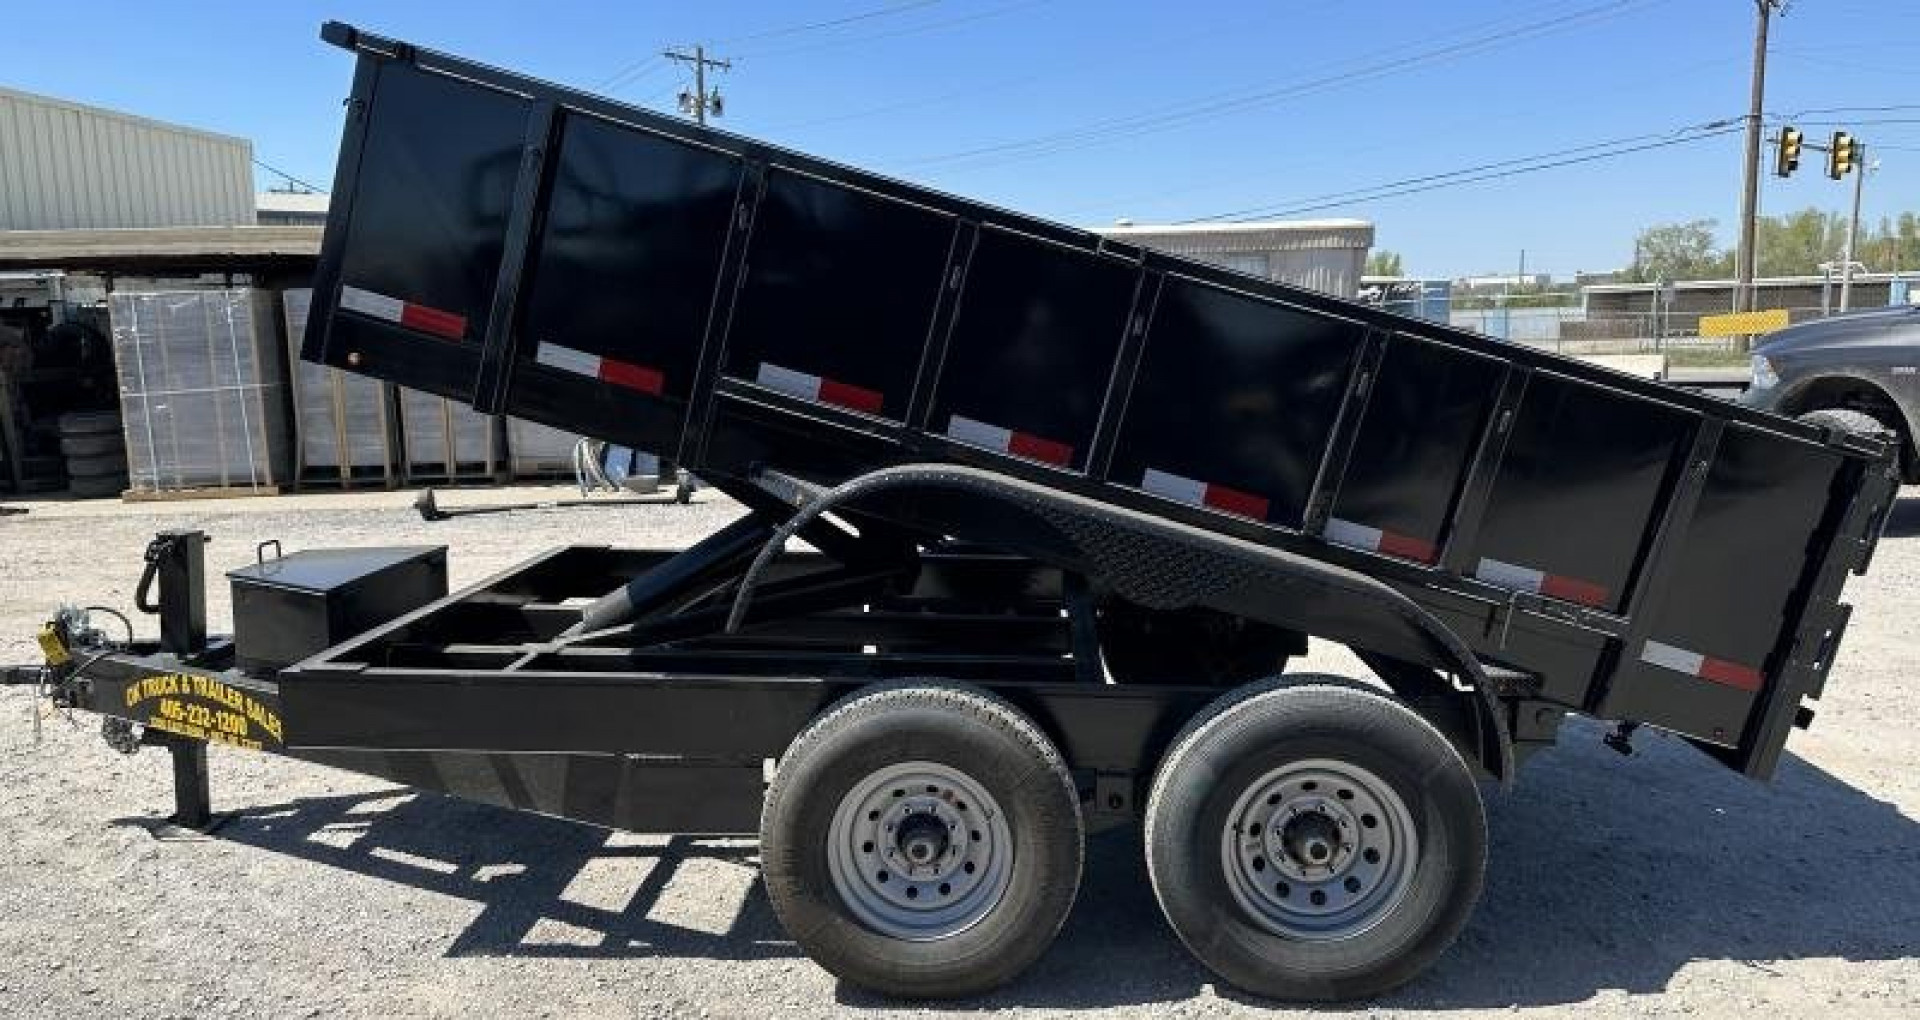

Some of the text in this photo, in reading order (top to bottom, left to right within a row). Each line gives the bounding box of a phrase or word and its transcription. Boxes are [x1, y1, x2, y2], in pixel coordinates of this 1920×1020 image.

[126, 681, 140, 707] OK
[142, 674, 178, 697] TRUCK
[181, 672, 191, 694] &
[194, 676, 243, 712] TRAILER
[246, 697, 284, 744] SALES
